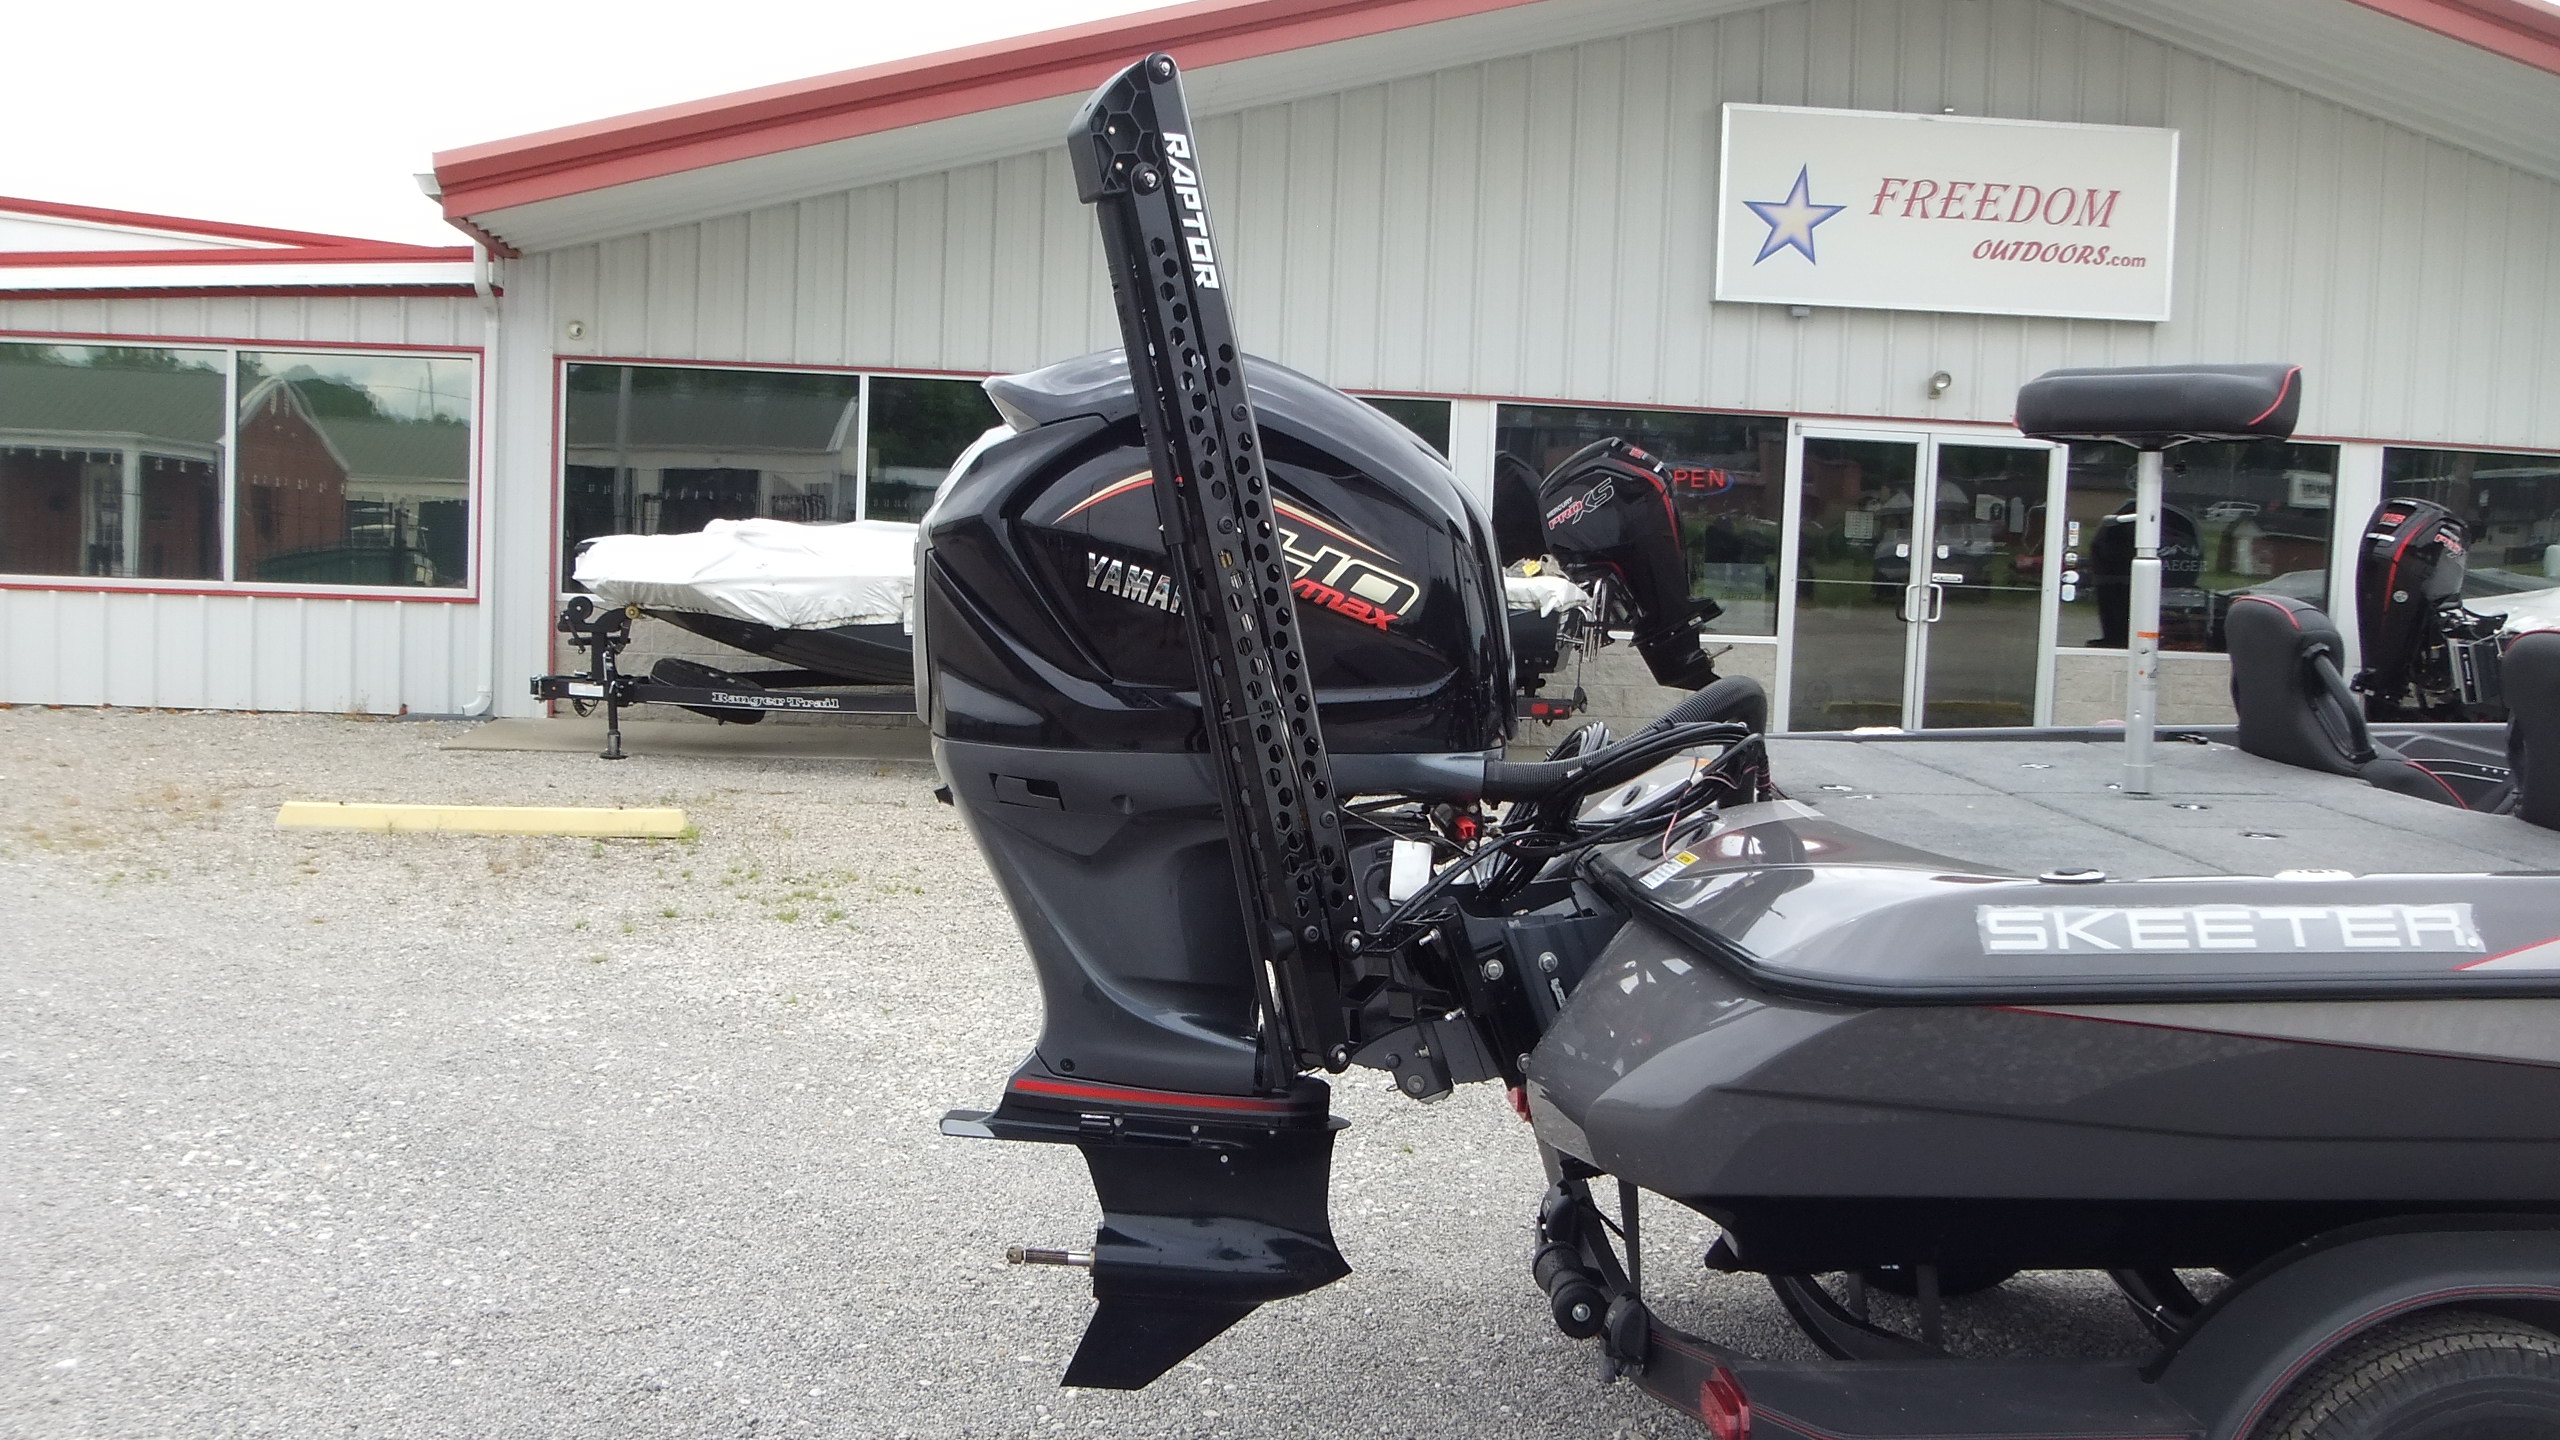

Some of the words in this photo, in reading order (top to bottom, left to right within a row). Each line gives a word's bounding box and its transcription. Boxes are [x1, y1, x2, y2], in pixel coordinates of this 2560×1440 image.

[1162, 132, 1220, 289] RAPTOR
[1868, 177, 2122, 229] FREEDOM
[1673, 469, 1726, 488] PEN
[1546, 495, 1574, 519] MERCURY
[1086, 551, 1186, 617] YAMA
[2161, 560, 2209, 572] AEGER
[1291, 578, 1400, 632] max
[712, 691, 786, 707] Ranger
[786, 696, 841, 709] Trail
[1986, 909, 2468, 951] SKEETER
